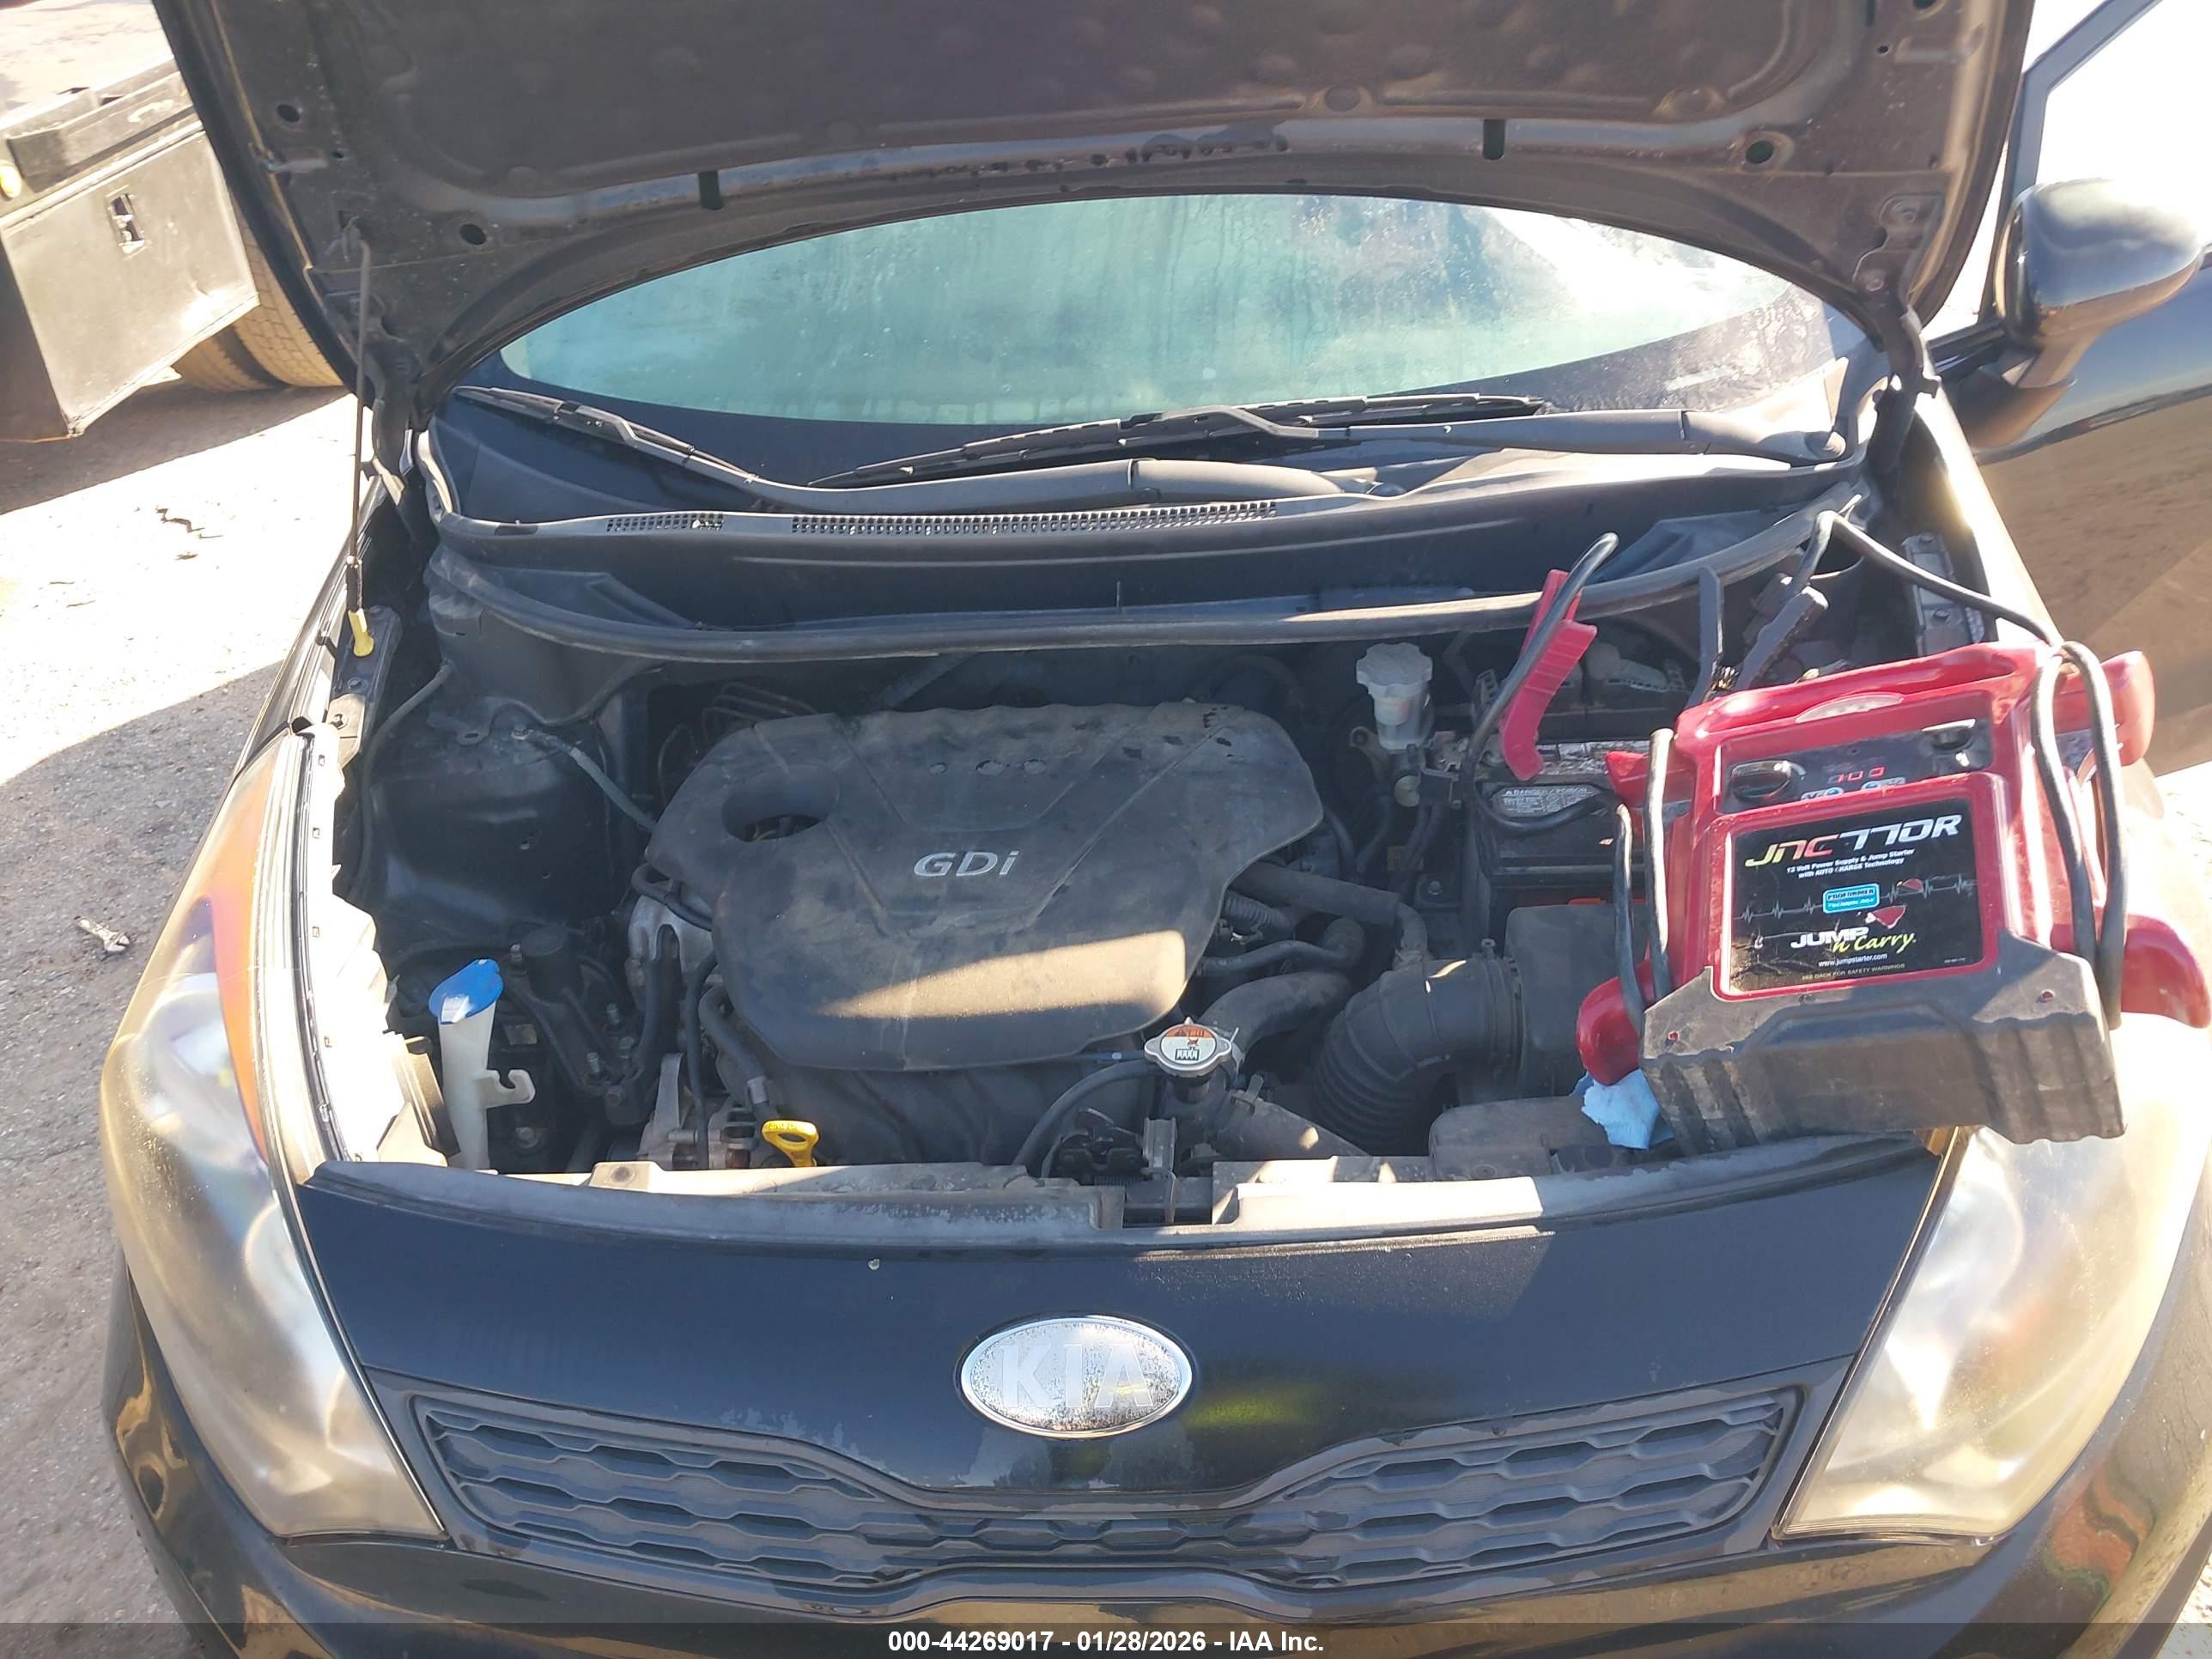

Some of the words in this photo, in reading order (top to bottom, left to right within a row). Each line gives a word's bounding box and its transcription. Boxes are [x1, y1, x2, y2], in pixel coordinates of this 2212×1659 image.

[914, 850, 1020, 877] GDi
[1796, 864, 1811, 872] Volt
[1812, 861, 1834, 870] Power
[1835, 857, 1860, 866] Supply
[1868, 853, 1888, 862] Jump
[1889, 848, 1916, 858] Starter
[1798, 871, 1814, 879] with
[1815, 868, 1833, 877] AUTO
[1864, 857, 1905, 869] Technology
[1790, 927, 1869, 948] JUMP
[1854, 933, 1916, 954] Carry
[1818, 952, 1888, 968] www.jumpstarter.com
[1847, 967, 1871, 975] SAFETY
[1872, 963, 1905, 972] WARNINGS
[1000, 1343, 1154, 1408] KIA
